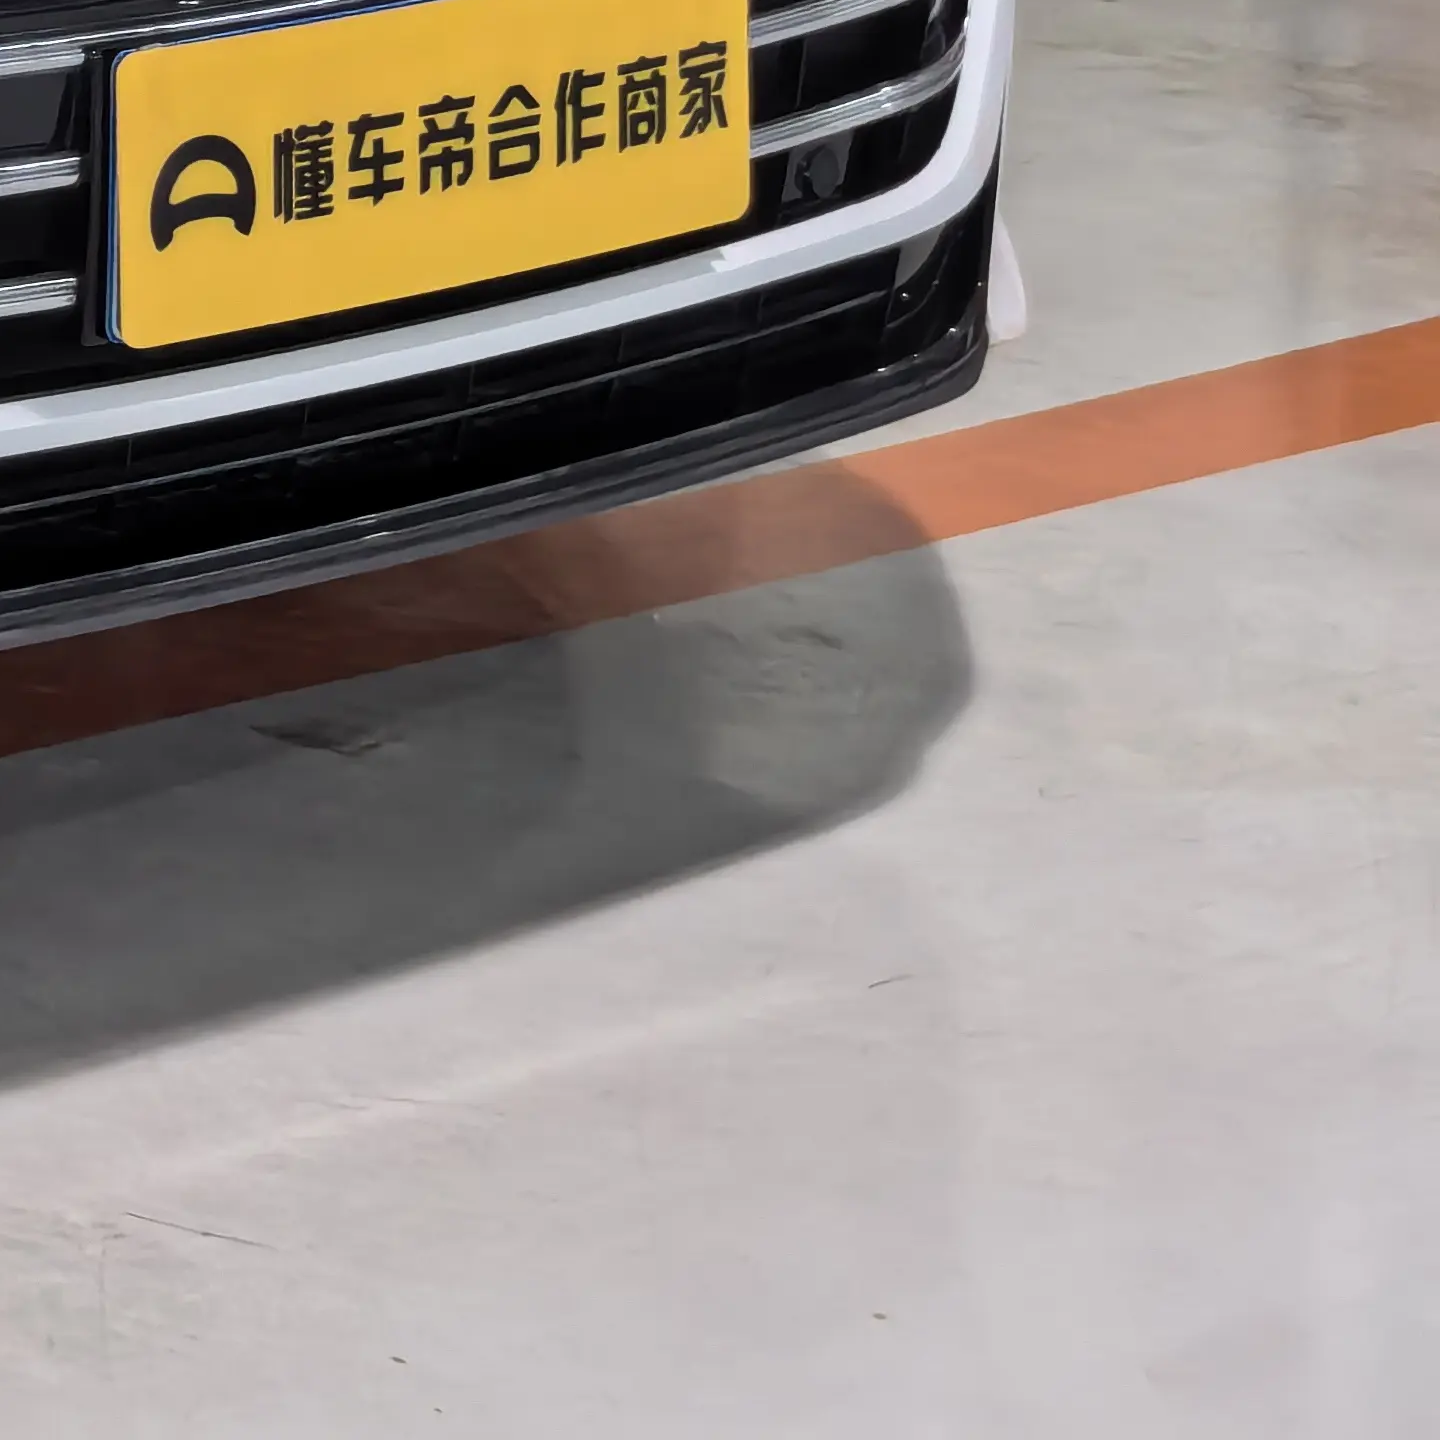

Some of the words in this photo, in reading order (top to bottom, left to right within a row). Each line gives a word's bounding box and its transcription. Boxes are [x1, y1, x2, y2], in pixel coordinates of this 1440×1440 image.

[273, 40, 728, 224] 懂车帝合作商家
